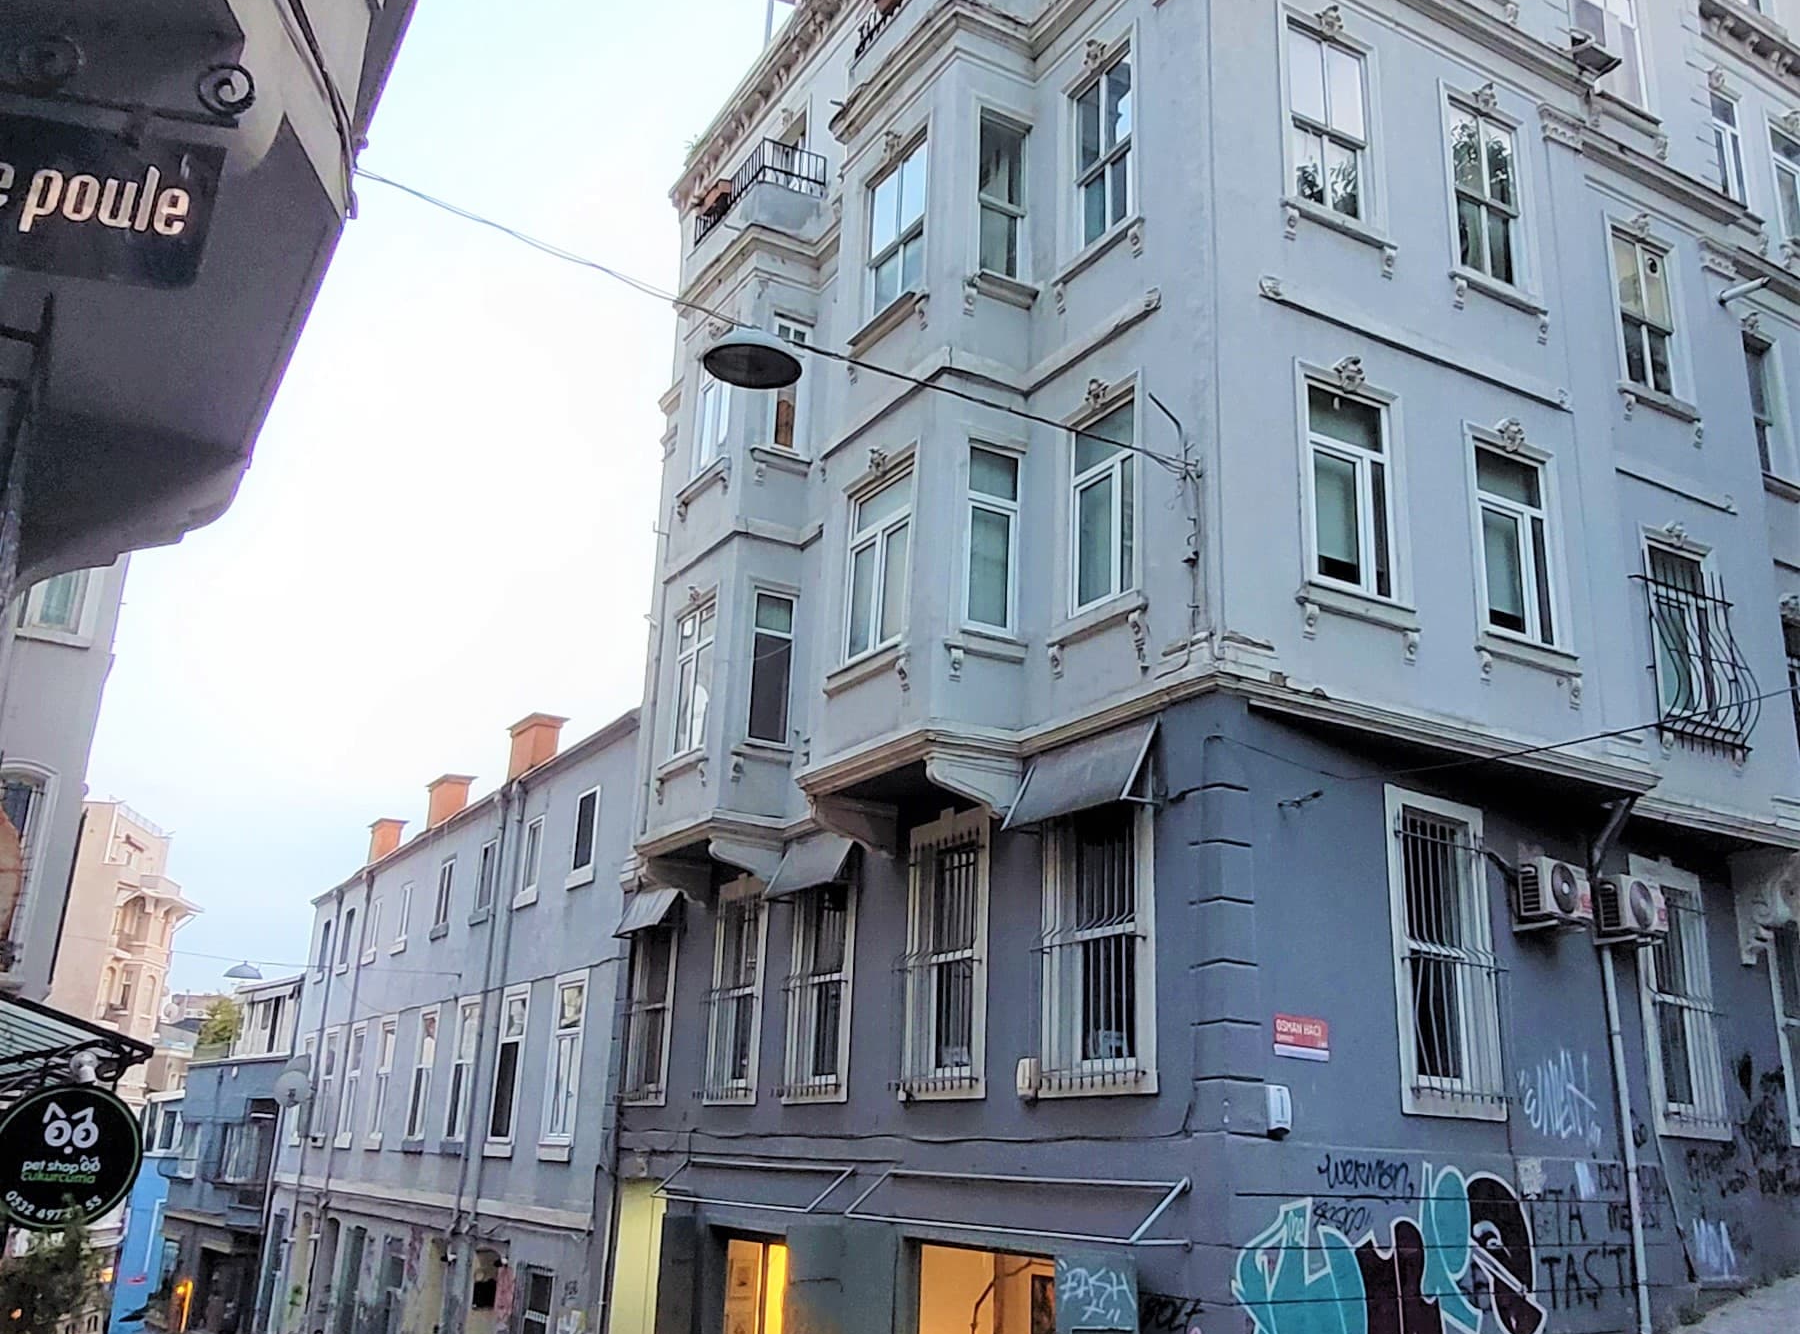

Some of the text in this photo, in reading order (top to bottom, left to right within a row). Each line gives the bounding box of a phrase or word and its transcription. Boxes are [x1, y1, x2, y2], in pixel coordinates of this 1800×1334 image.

[18, 165, 190, 236] poule
[22, 1160, 79, 1174] pet shop
[5, 1190, 35, 1216] 0532
